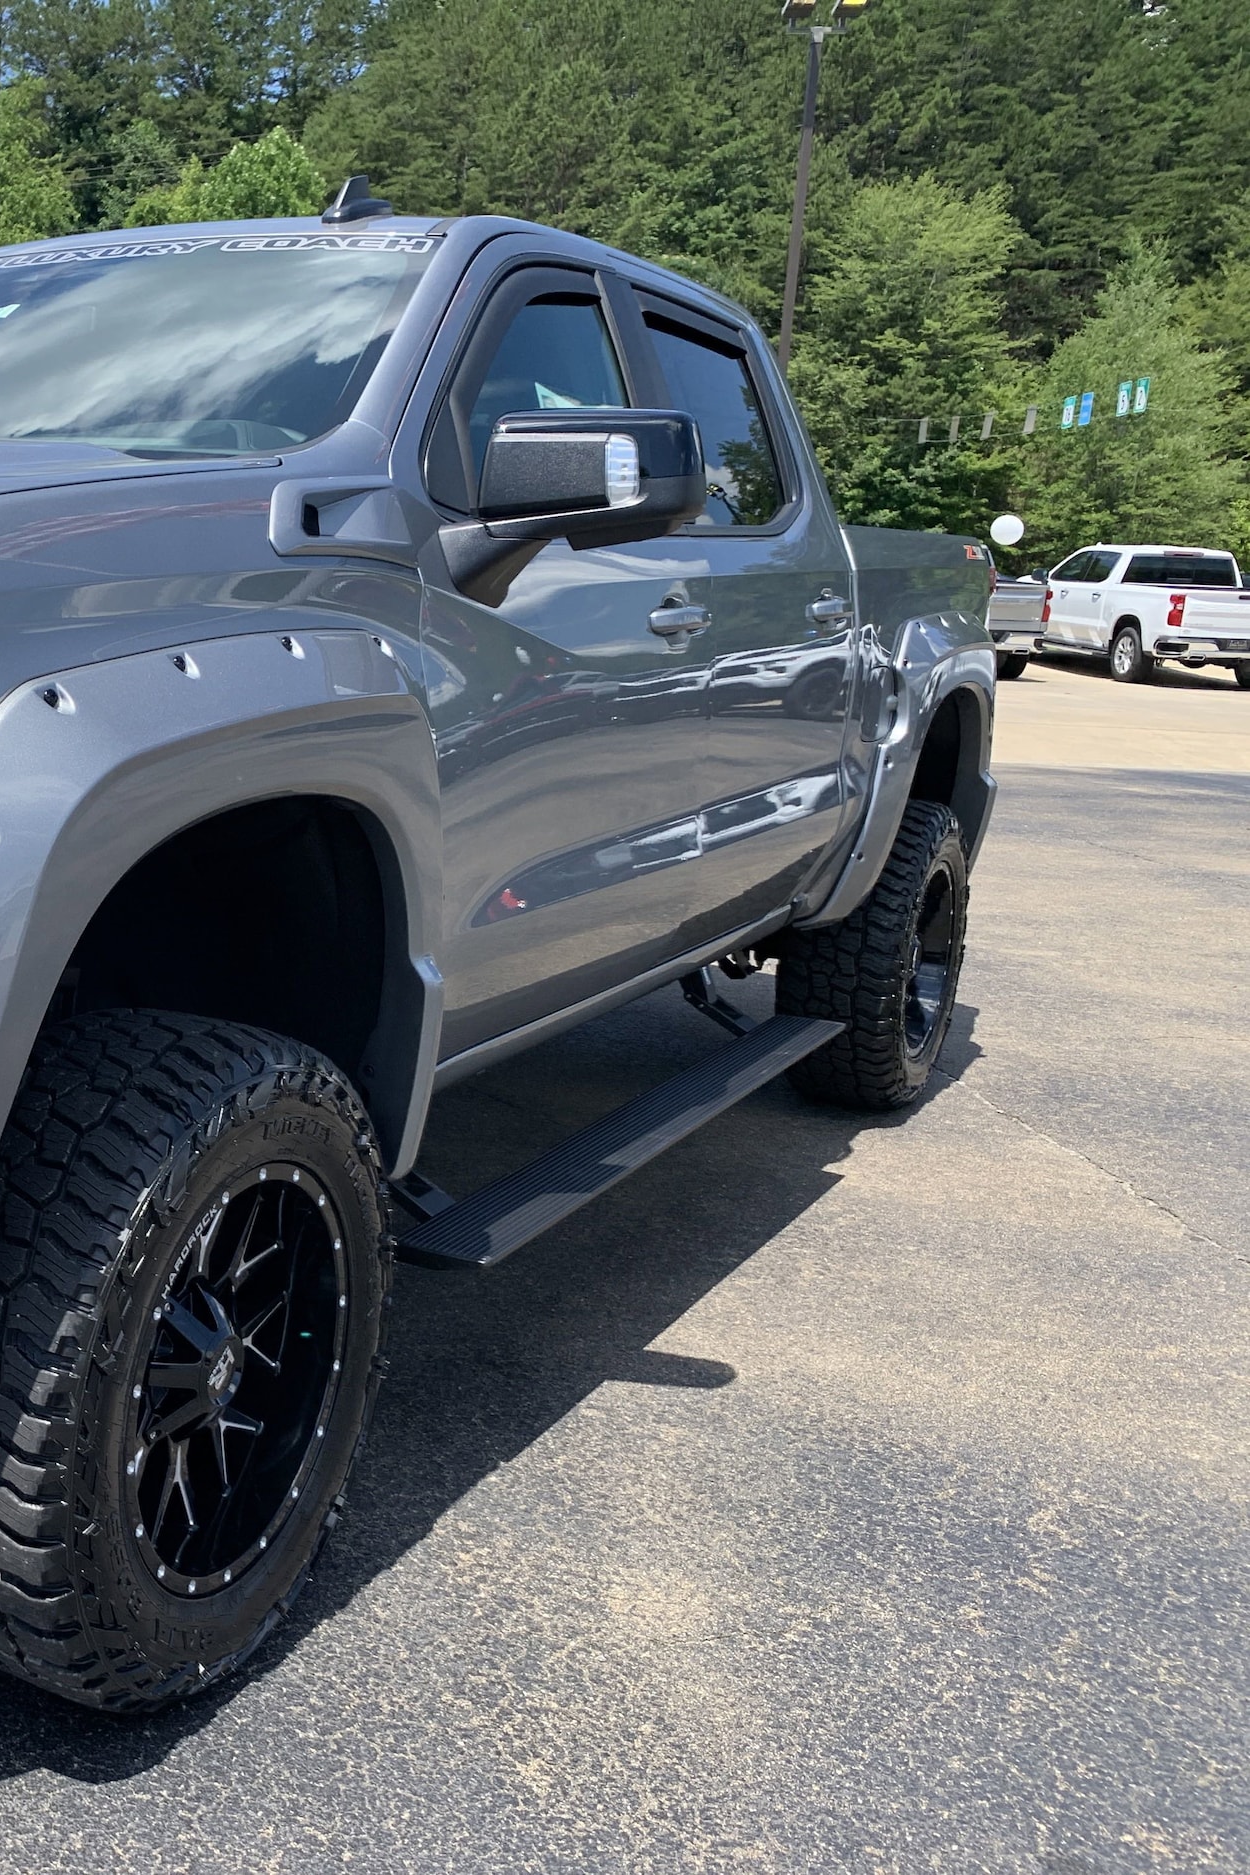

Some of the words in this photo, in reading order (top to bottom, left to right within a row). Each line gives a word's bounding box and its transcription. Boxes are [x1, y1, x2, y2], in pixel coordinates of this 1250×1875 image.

[0, 239, 221, 269] LUXURY
[220, 236, 435, 254] COACH
[161, 1203, 218, 1300] HARDROCK
